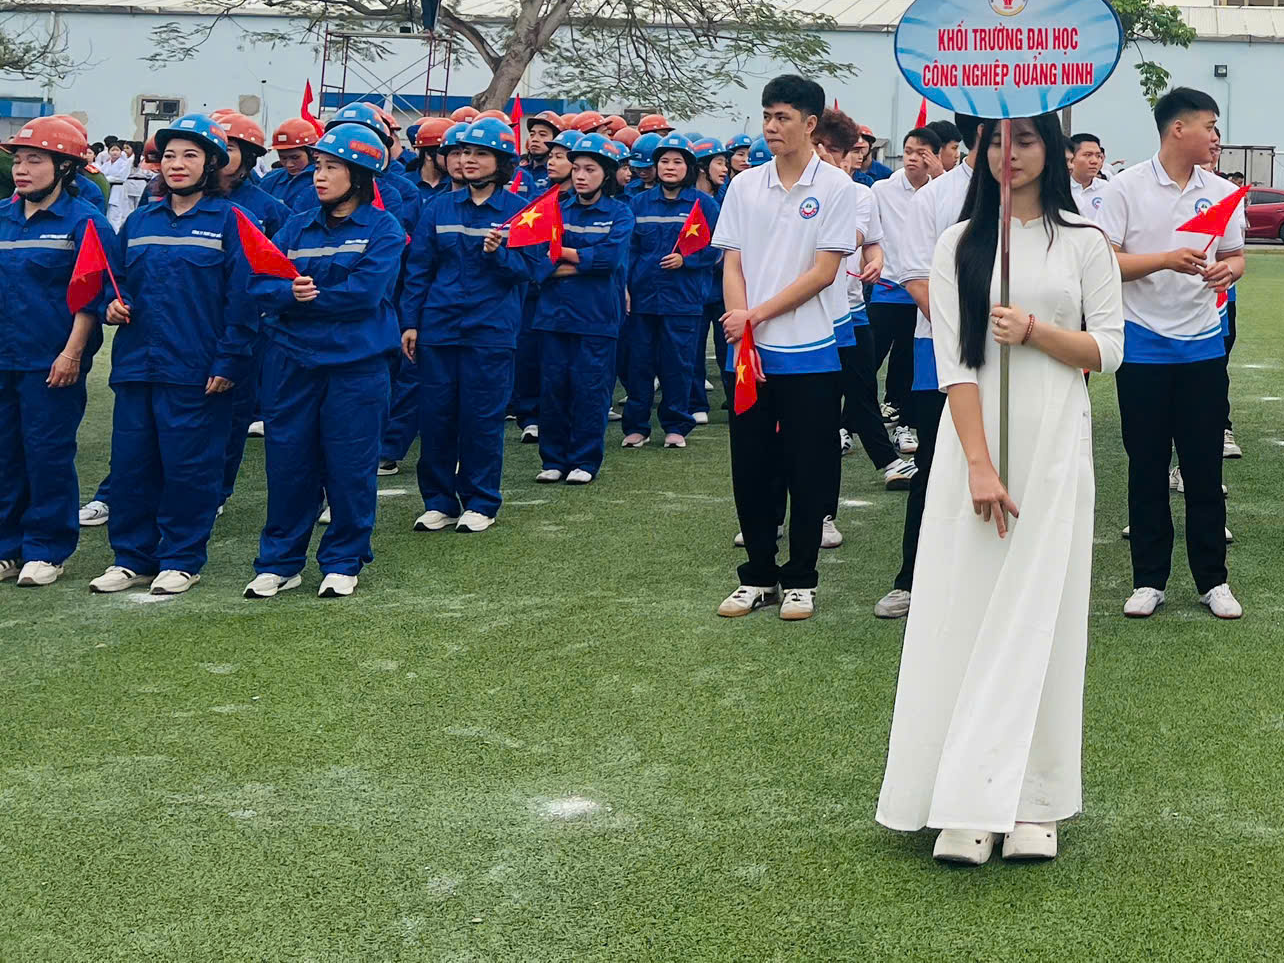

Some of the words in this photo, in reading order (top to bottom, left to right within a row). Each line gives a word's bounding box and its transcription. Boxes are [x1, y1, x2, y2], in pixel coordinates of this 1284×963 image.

[938, 20, 968, 51] KHỐI
[972, 22, 1023, 51] TRƯỜNG
[1027, 27, 1048, 55] ĐẠI
[1053, 27, 1079, 55] HỌC
[923, 59, 958, 87] CÔNG
[962, 59, 1009, 91] NGHIỆP
[1013, 55, 1057, 88] QUẢNG
[1061, 62, 1093, 85] NINH
